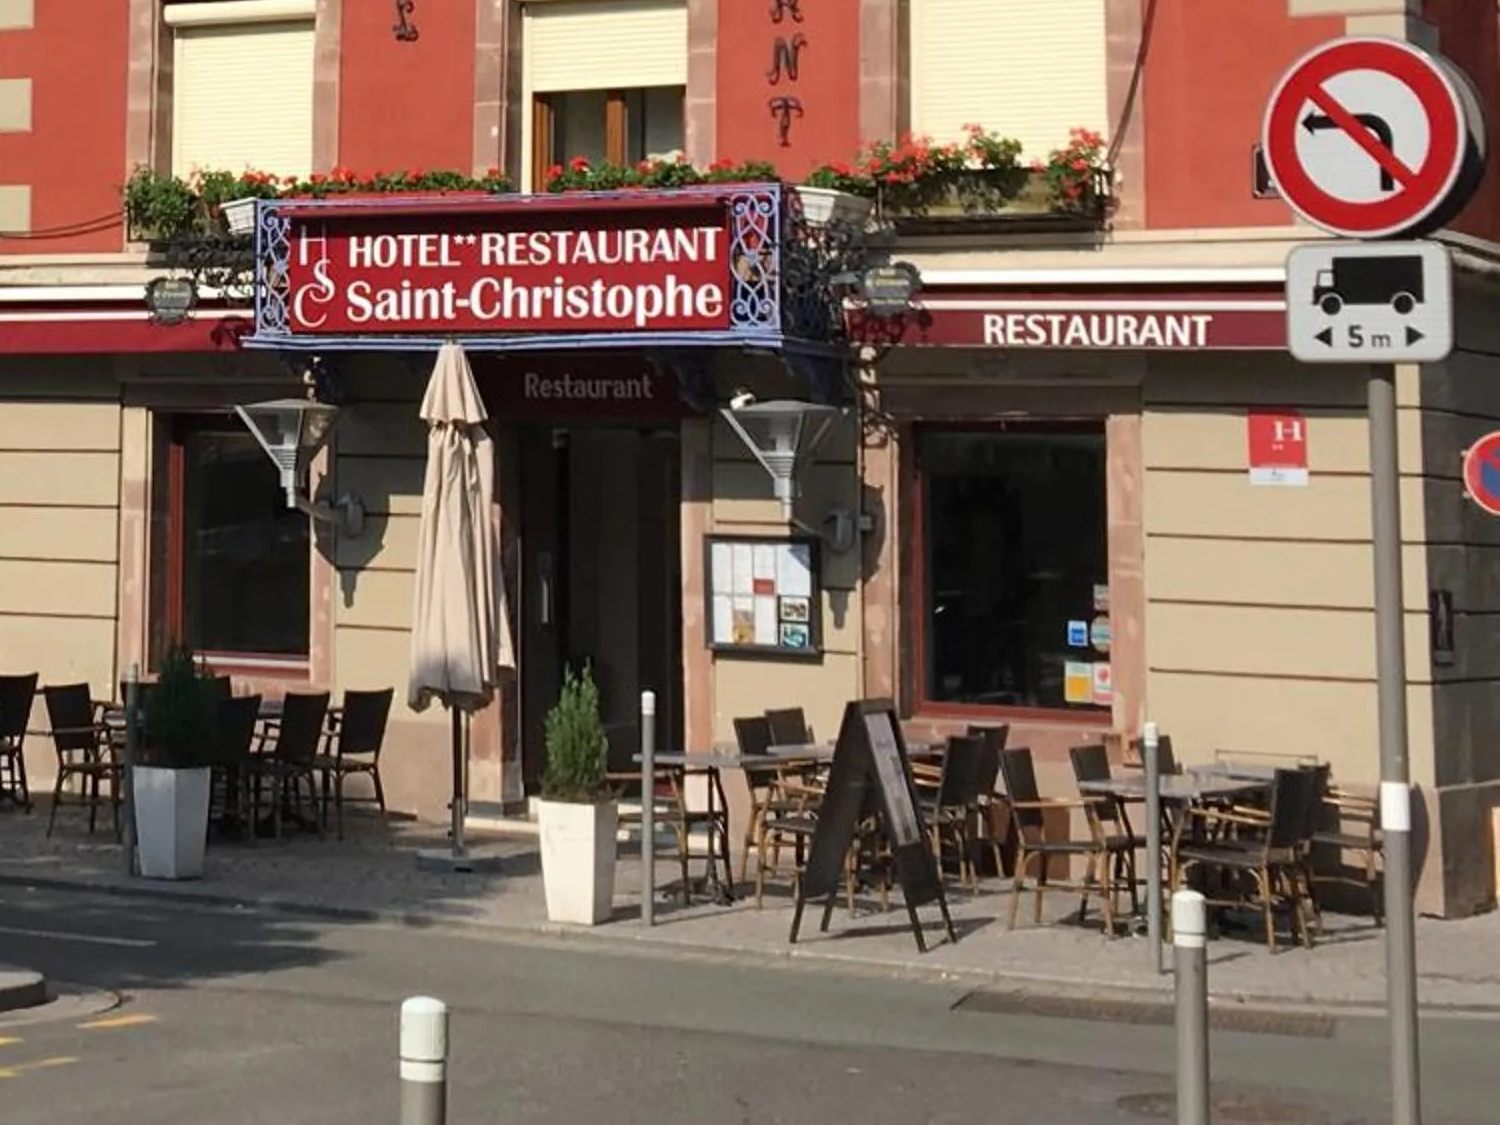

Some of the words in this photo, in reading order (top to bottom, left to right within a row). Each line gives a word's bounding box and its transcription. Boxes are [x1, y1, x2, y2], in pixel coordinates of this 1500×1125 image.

[480, 227, 723, 266] RESTAURANT
[346, 274, 723, 327] Saint-Christophe
[983, 314, 1213, 347] RESTAURANT
[1348, 324, 1364, 349] 5
[1371, 332, 1392, 348] m
[523, 372, 654, 400] Restaurant
